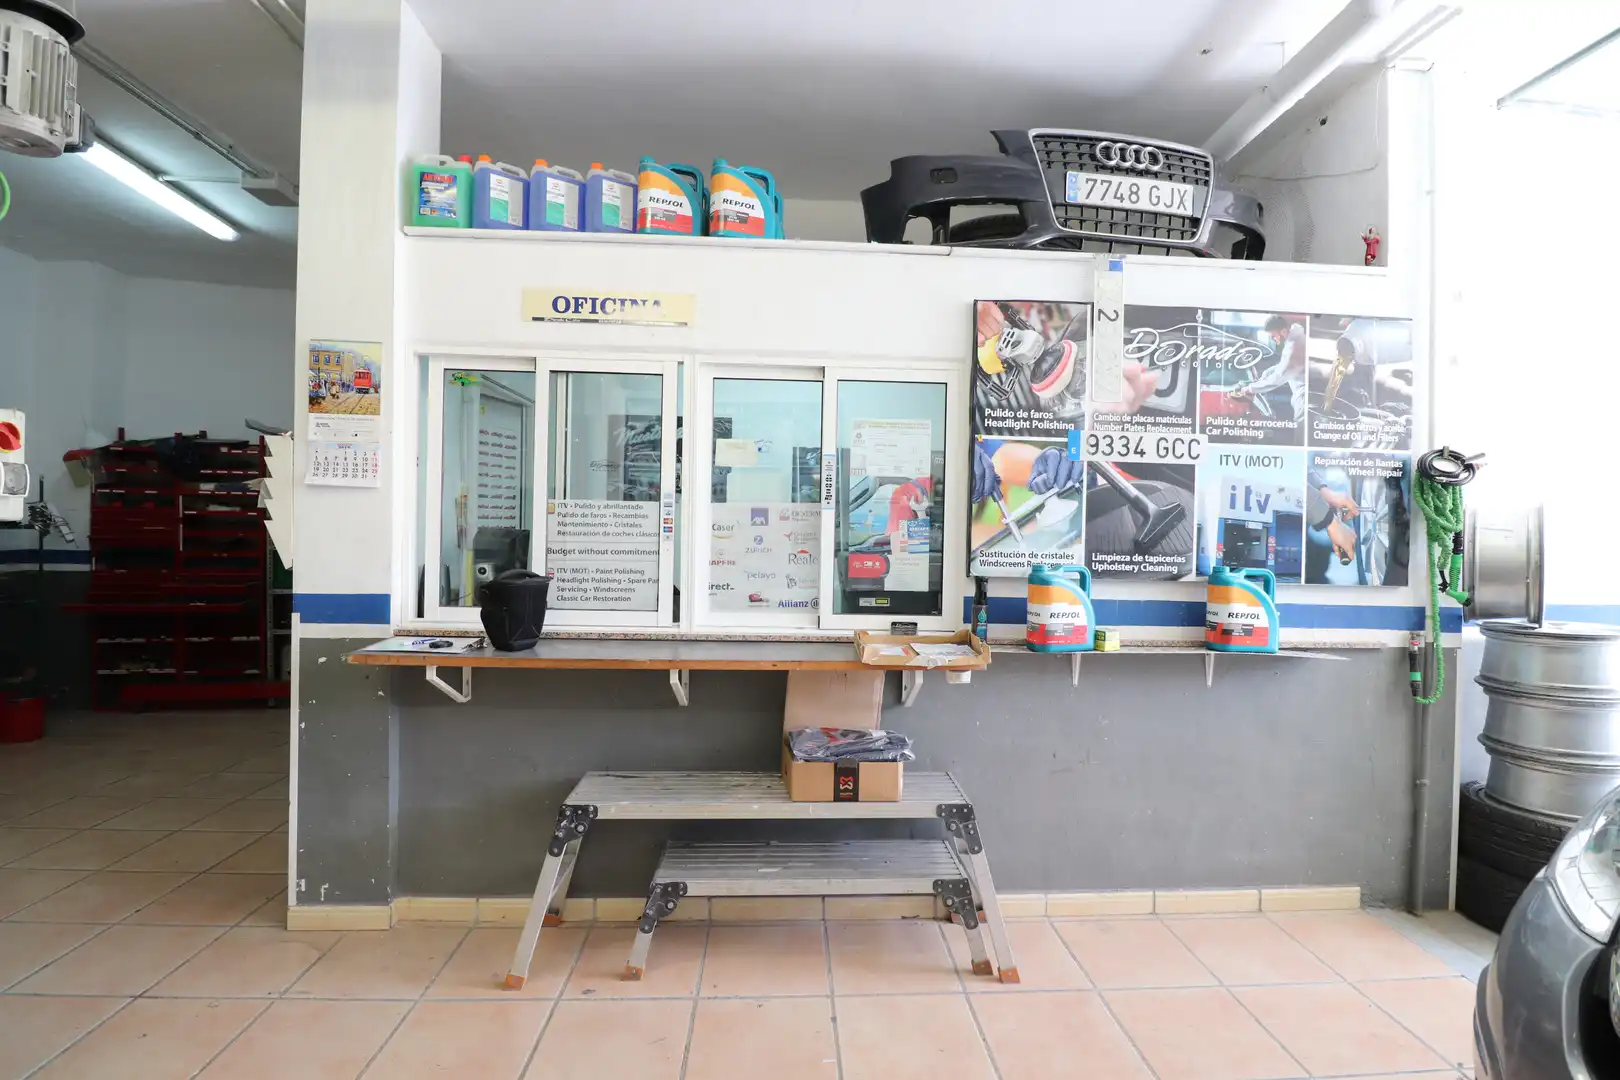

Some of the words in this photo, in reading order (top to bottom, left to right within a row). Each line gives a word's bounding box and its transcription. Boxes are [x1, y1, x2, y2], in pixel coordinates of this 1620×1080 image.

[1085, 178, 1140, 204] 7748
[1149, 185, 1187, 211] GJX
[648, 196, 684, 208] REPSOL
[722, 198, 756, 210] REPSOL
[1181, 360, 1234, 370] color
[984, 408, 1015, 419] Pulido
[1017, 410, 1028, 418] de
[1030, 410, 1054, 419] faros
[1094, 413, 1120, 422] Cambio
[1122, 414, 1131, 422] de
[1133, 414, 1154, 424] placas
[1156, 414, 1192, 424] matrículas
[984, 419, 1030, 430] Headlight
[1032, 421, 1074, 430] Polishing
[1206, 417, 1234, 425] Pulido
[1237, 418, 1248, 426] de
[1314, 421, 1344, 430] Cambios
[1346, 422, 1355, 430] de
[1094, 423, 1122, 432] Number
[1124, 424, 1145, 432] Plates
[1147, 424, 1192, 434] Replacement
[1206, 427, 1221, 435] Car
[1223, 427, 1264, 438] Polishing
[1314, 431, 1341, 441] Change
[1342, 432, 1350, 440] of
[1362, 433, 1376, 441] and
[1378, 433, 1399, 442] Filters
[1086, 433, 1146, 458] 9334
[1156, 436, 1200, 459] GCC
[1219, 455, 1240, 466] ITV
[1244, 455, 1284, 469] (MOT)
[1315, 457, 1361, 467] Reparación
[1376, 459, 1403, 468] llantas
[1348, 468, 1374, 476] Wheel
[1377, 469, 1403, 478] Repair
[1230, 485, 1271, 514] itv
[712, 523, 735, 531] Caser
[547, 548, 576, 556] Budget
[979, 550, 1026, 559] Sustitución
[1040, 552, 1074, 560] cristales
[788, 553, 818, 565] Reale
[979, 559, 1025, 568] Windscreens
[1092, 553, 1130, 563] Limpieza
[1132, 554, 1143, 562] de
[1145, 553, 1186, 564] tapicerías
[1092, 563, 1140, 573] Upholstery
[1141, 564, 1178, 574] Cleaning
